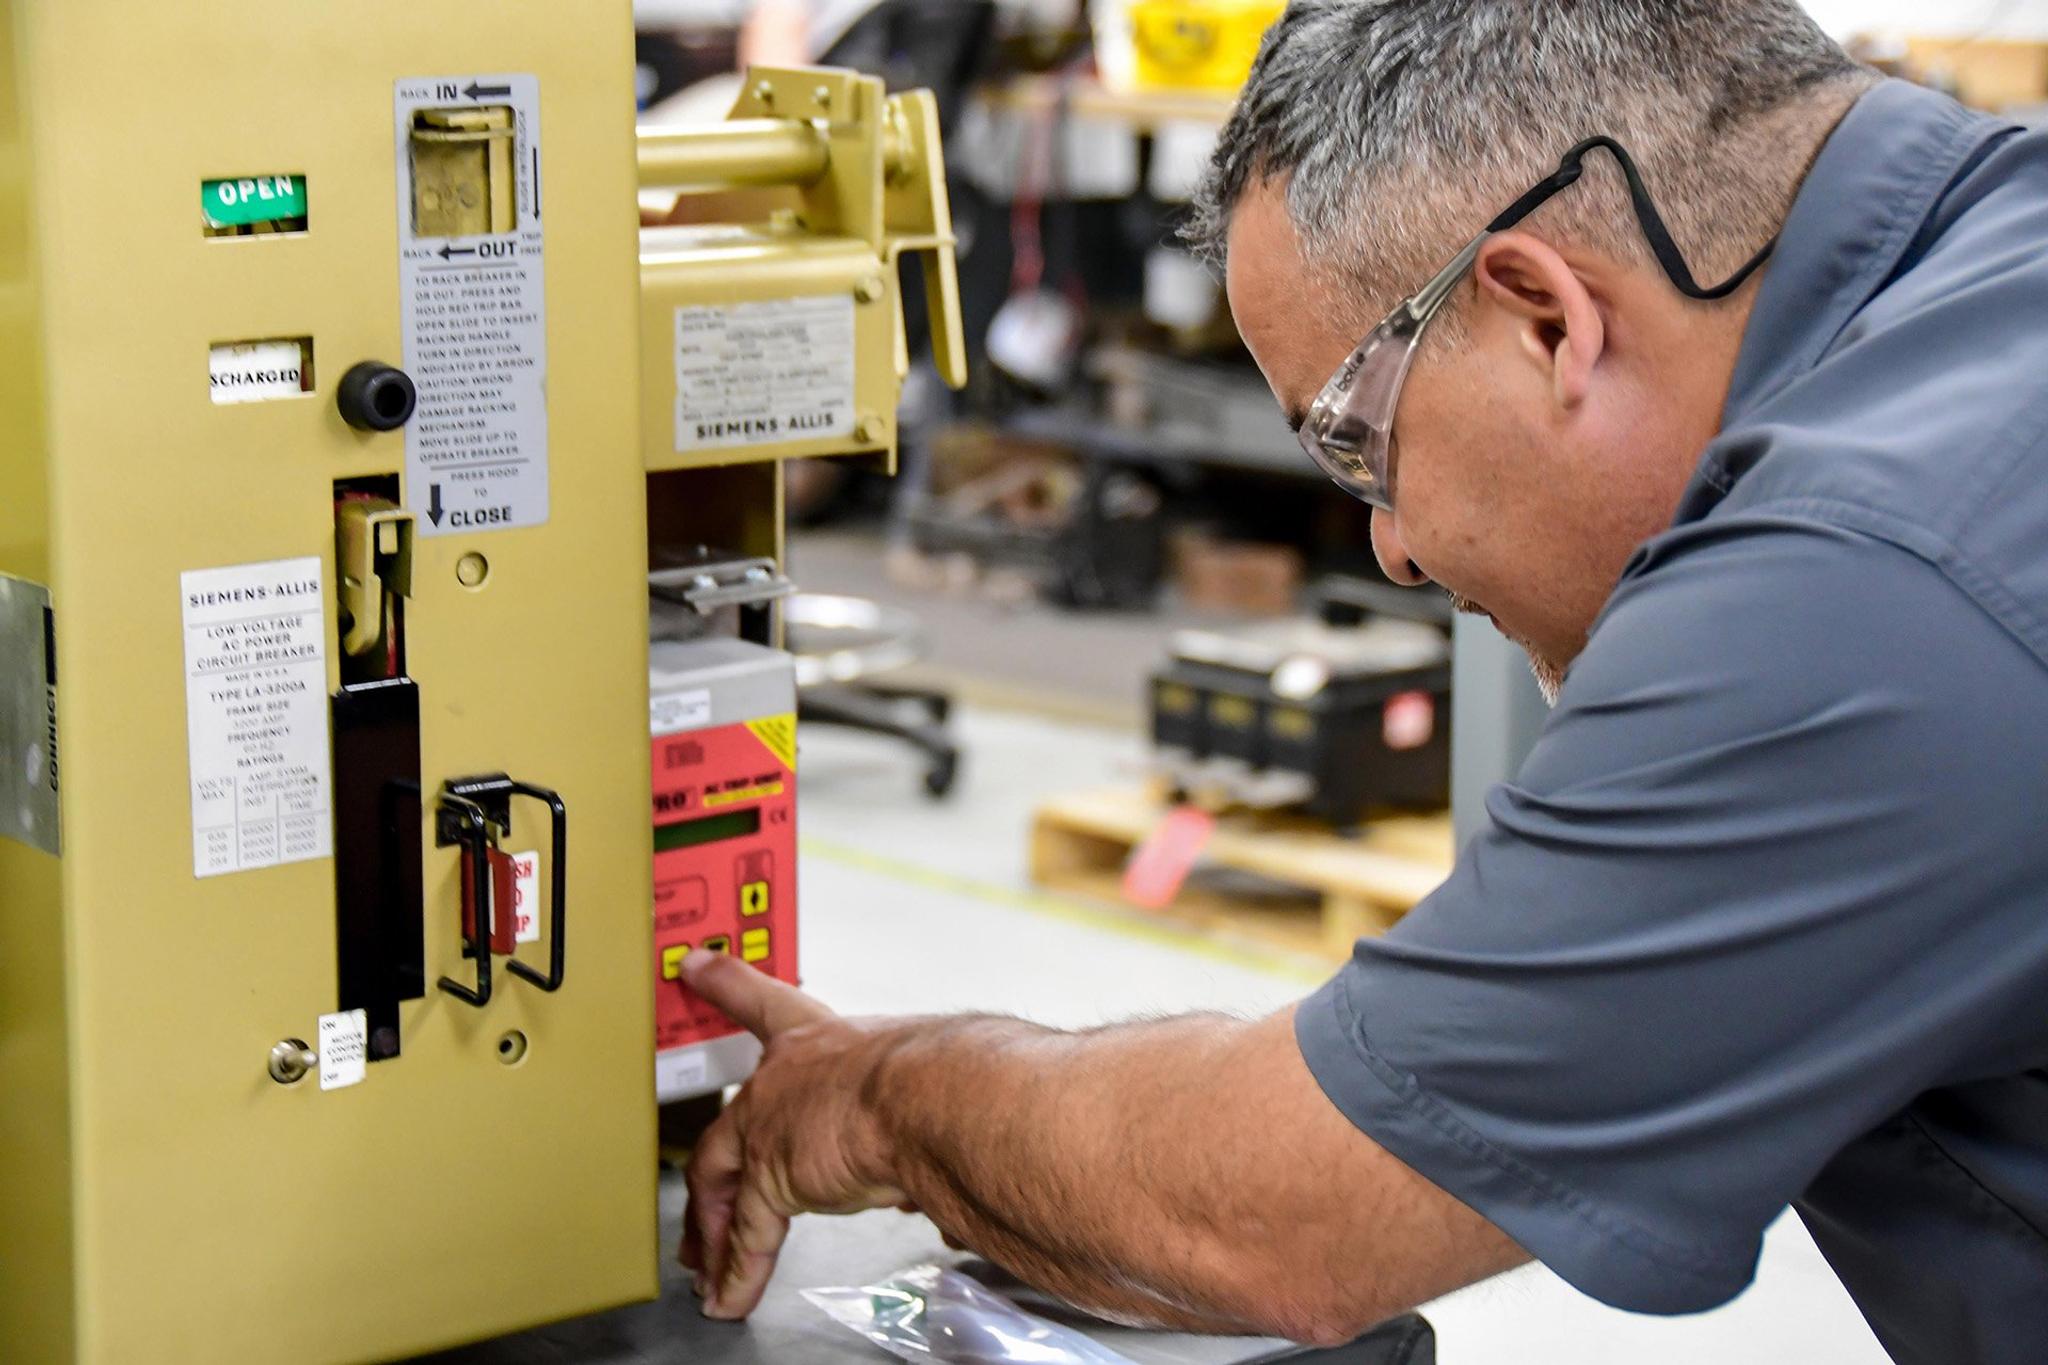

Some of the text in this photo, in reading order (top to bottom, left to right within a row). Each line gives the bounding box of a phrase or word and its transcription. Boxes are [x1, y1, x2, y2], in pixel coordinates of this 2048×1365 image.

[436, 85, 457, 99] IN
[218, 175, 295, 206] OPEN
[479, 241, 517, 258] OUT
[415, 271, 527, 285] TO RACK BREAKER IN
[416, 291, 430, 301] OR
[461, 288, 495, 297] PRESS
[498, 286, 521, 294] AND
[416, 301, 522, 315] HOLD RED TRIP BAR
[417, 314, 538, 331] OPEN SLIDE TO INSERT
[417, 331, 511, 345] RACKING HANDLE
[417, 344, 521, 360] TURN IN DIRECTION
[417, 357, 535, 374] INDICATED BY ARROW
[472, 374, 513, 385] WRONG
[418, 390, 503, 404] DIRECTION MAY
[419, 403, 516, 418] DAMAGE RACKING
[419, 420, 486, 433] MECHANISM
[419, 431, 518, 449] MOVE SLIDE UP TO
[419, 446, 519, 464] OPERATE BREAKER
[451, 468, 519, 481] PRESS HOOD
[474, 488, 487, 497] TO
[450, 505, 512, 527] CLOSE
[222, 632, 292, 651] AC POWER
[197, 643, 315, 670] CIRCUIT BREAKER
[210, 687, 242, 703] TYPE
[226, 700, 290, 716] FRAME SIZE
[45, 688, 57, 792] CONNECT
[228, 726, 290, 743] FREQUENCY
[237, 752, 284, 768] RATINGS
